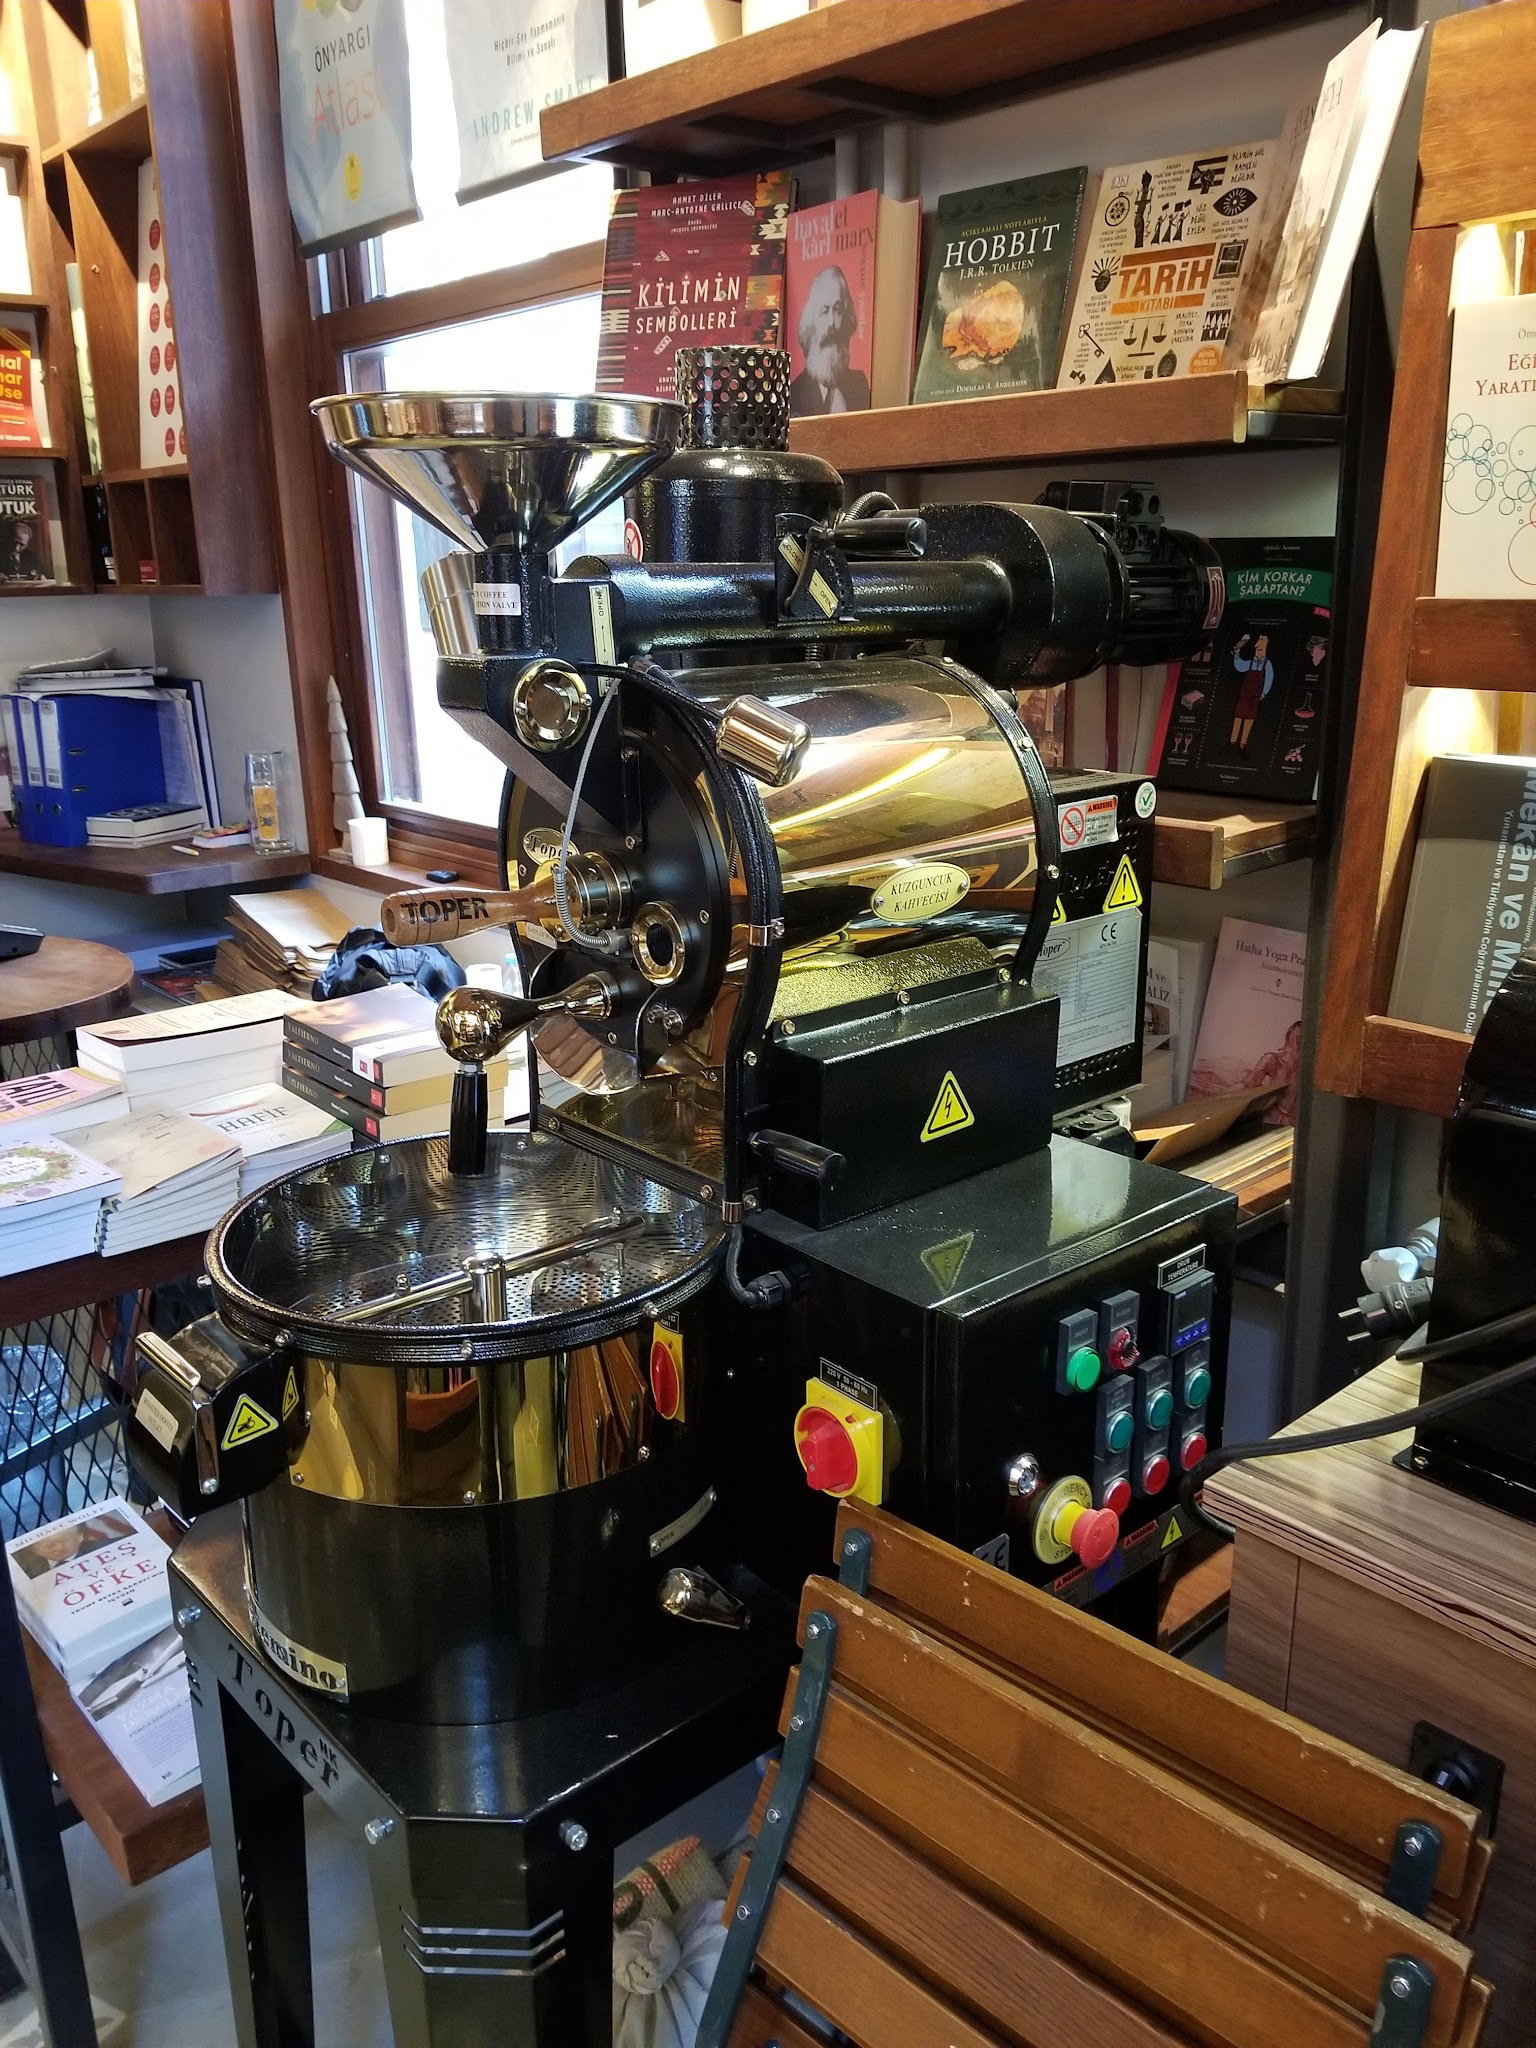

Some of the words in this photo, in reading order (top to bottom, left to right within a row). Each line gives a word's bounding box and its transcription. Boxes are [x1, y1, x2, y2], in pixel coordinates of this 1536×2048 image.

[314, 25, 371, 73] ÖNYARGI
[472, 100, 534, 141] ANDREW
[651, 204, 708, 218] MARC-ANTOINE
[672, 194, 696, 206] AHMET
[700, 191, 722, 202] DİLER
[801, 229, 832, 261] karl
[835, 225, 875, 252] marx
[943, 223, 1061, 269] HOBBIT
[959, 262, 988, 281] J.R.R.
[991, 258, 1035, 274] TOLKIEN
[638, 271, 741, 308] KİLİMİN
[635, 306, 737, 335] SEMBOLLERİ
[956, 385, 985, 394] DOUGLAS
[994, 380, 1028, 390] ANDERSON
[1236, 570, 1260, 586] KİM
[1263, 571, 1313, 586] KORKAR
[1239, 584, 1306, 599] ŞARAPTAN?
[890, 872, 954, 896] KUZGUNCUK
[400, 896, 490, 925] TOPER
[894, 888, 950, 912] KAHVECİSİ
[1499, 892, 1525, 931] ve
[1235, 939, 1262, 957] Hatha
[1265, 945, 1289, 963] Yoga
[216, 1106, 290, 1133] HAFİF
[1167, 1260, 1199, 1281] TEMPERATURE
[1177, 1257, 1191, 1269] DRUM
[14, 1523, 65, 1548] MICHAEL
[53, 1541, 137, 1587] ATEŞ
[88, 1564, 117, 1579] VE
[63, 1558, 158, 1607] ÖFKE
[227, 1642, 340, 1790] Toper
